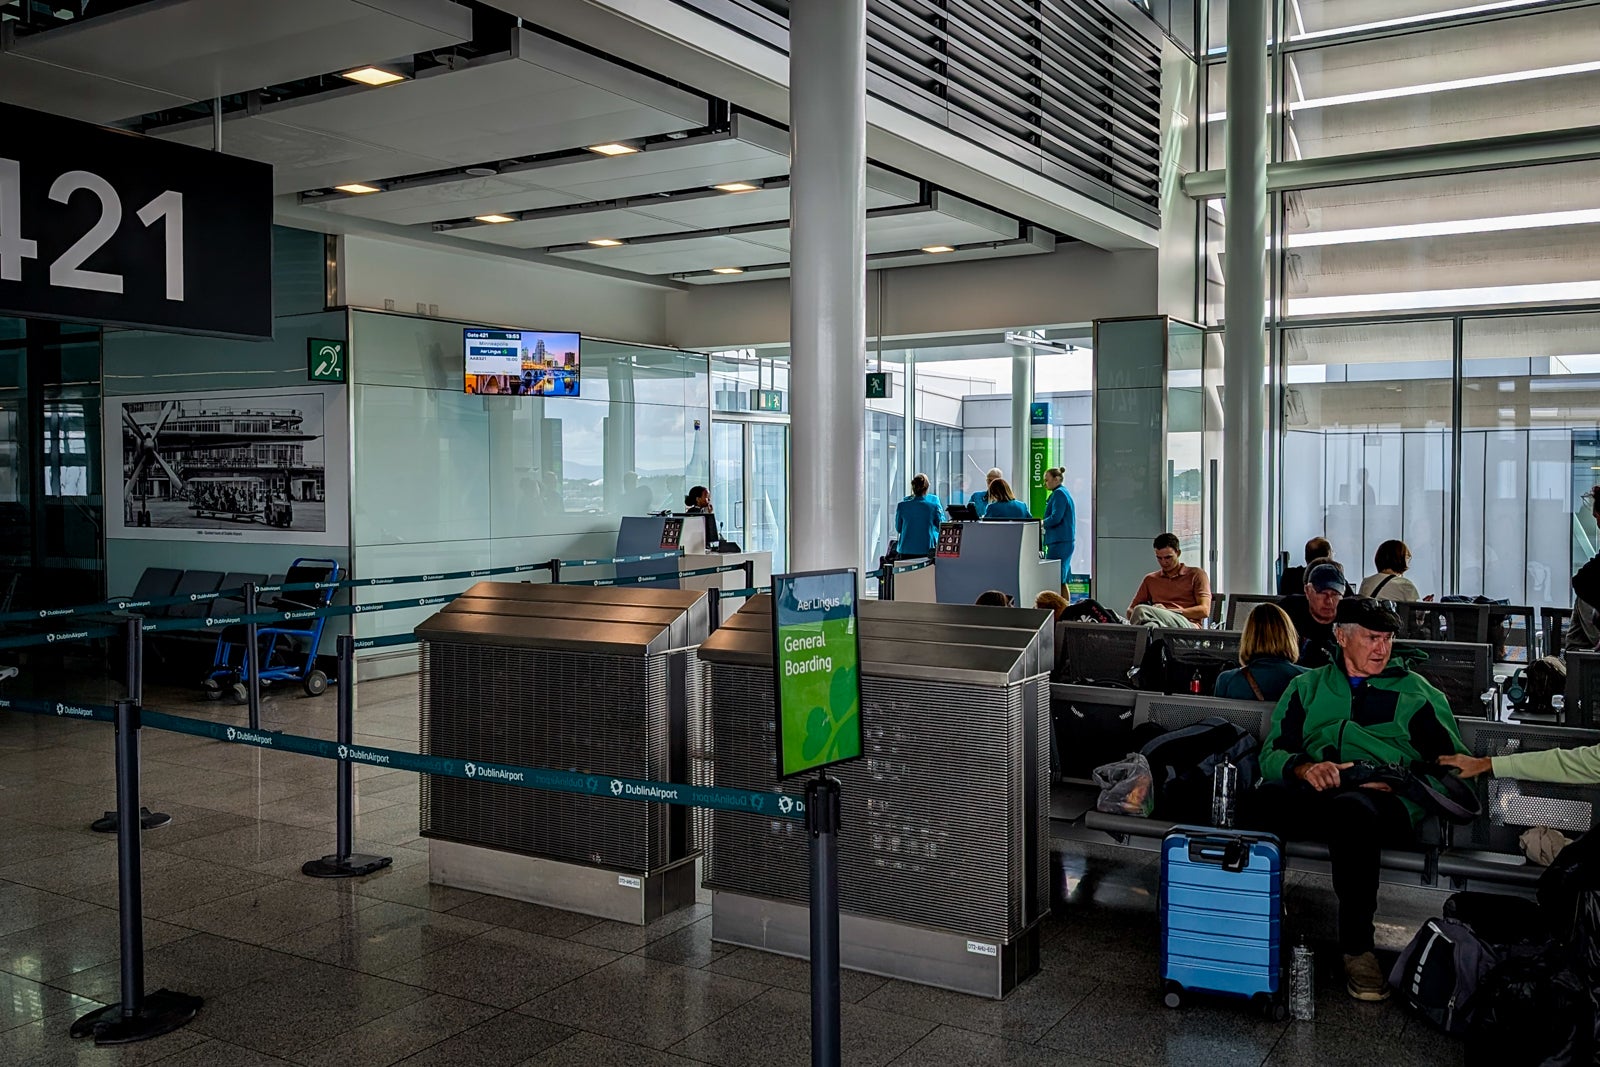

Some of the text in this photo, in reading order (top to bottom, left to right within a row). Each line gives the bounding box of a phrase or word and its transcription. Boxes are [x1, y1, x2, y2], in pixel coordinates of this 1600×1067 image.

[1033, 452, 1043, 482] Group
[797, 597, 840, 612] Aer Lingus
[56, 632, 88, 640] DublinAirport
[785, 631, 826, 652] General
[785, 656, 832, 676] Boarding
[64, 706, 93, 716] DublinAirport
[237, 730, 272, 745] DublinAirport
[349, 749, 390, 764] DublinAirport
[478, 766, 524, 782] DublinAirport
[625, 784, 678, 799] DublinAirport
